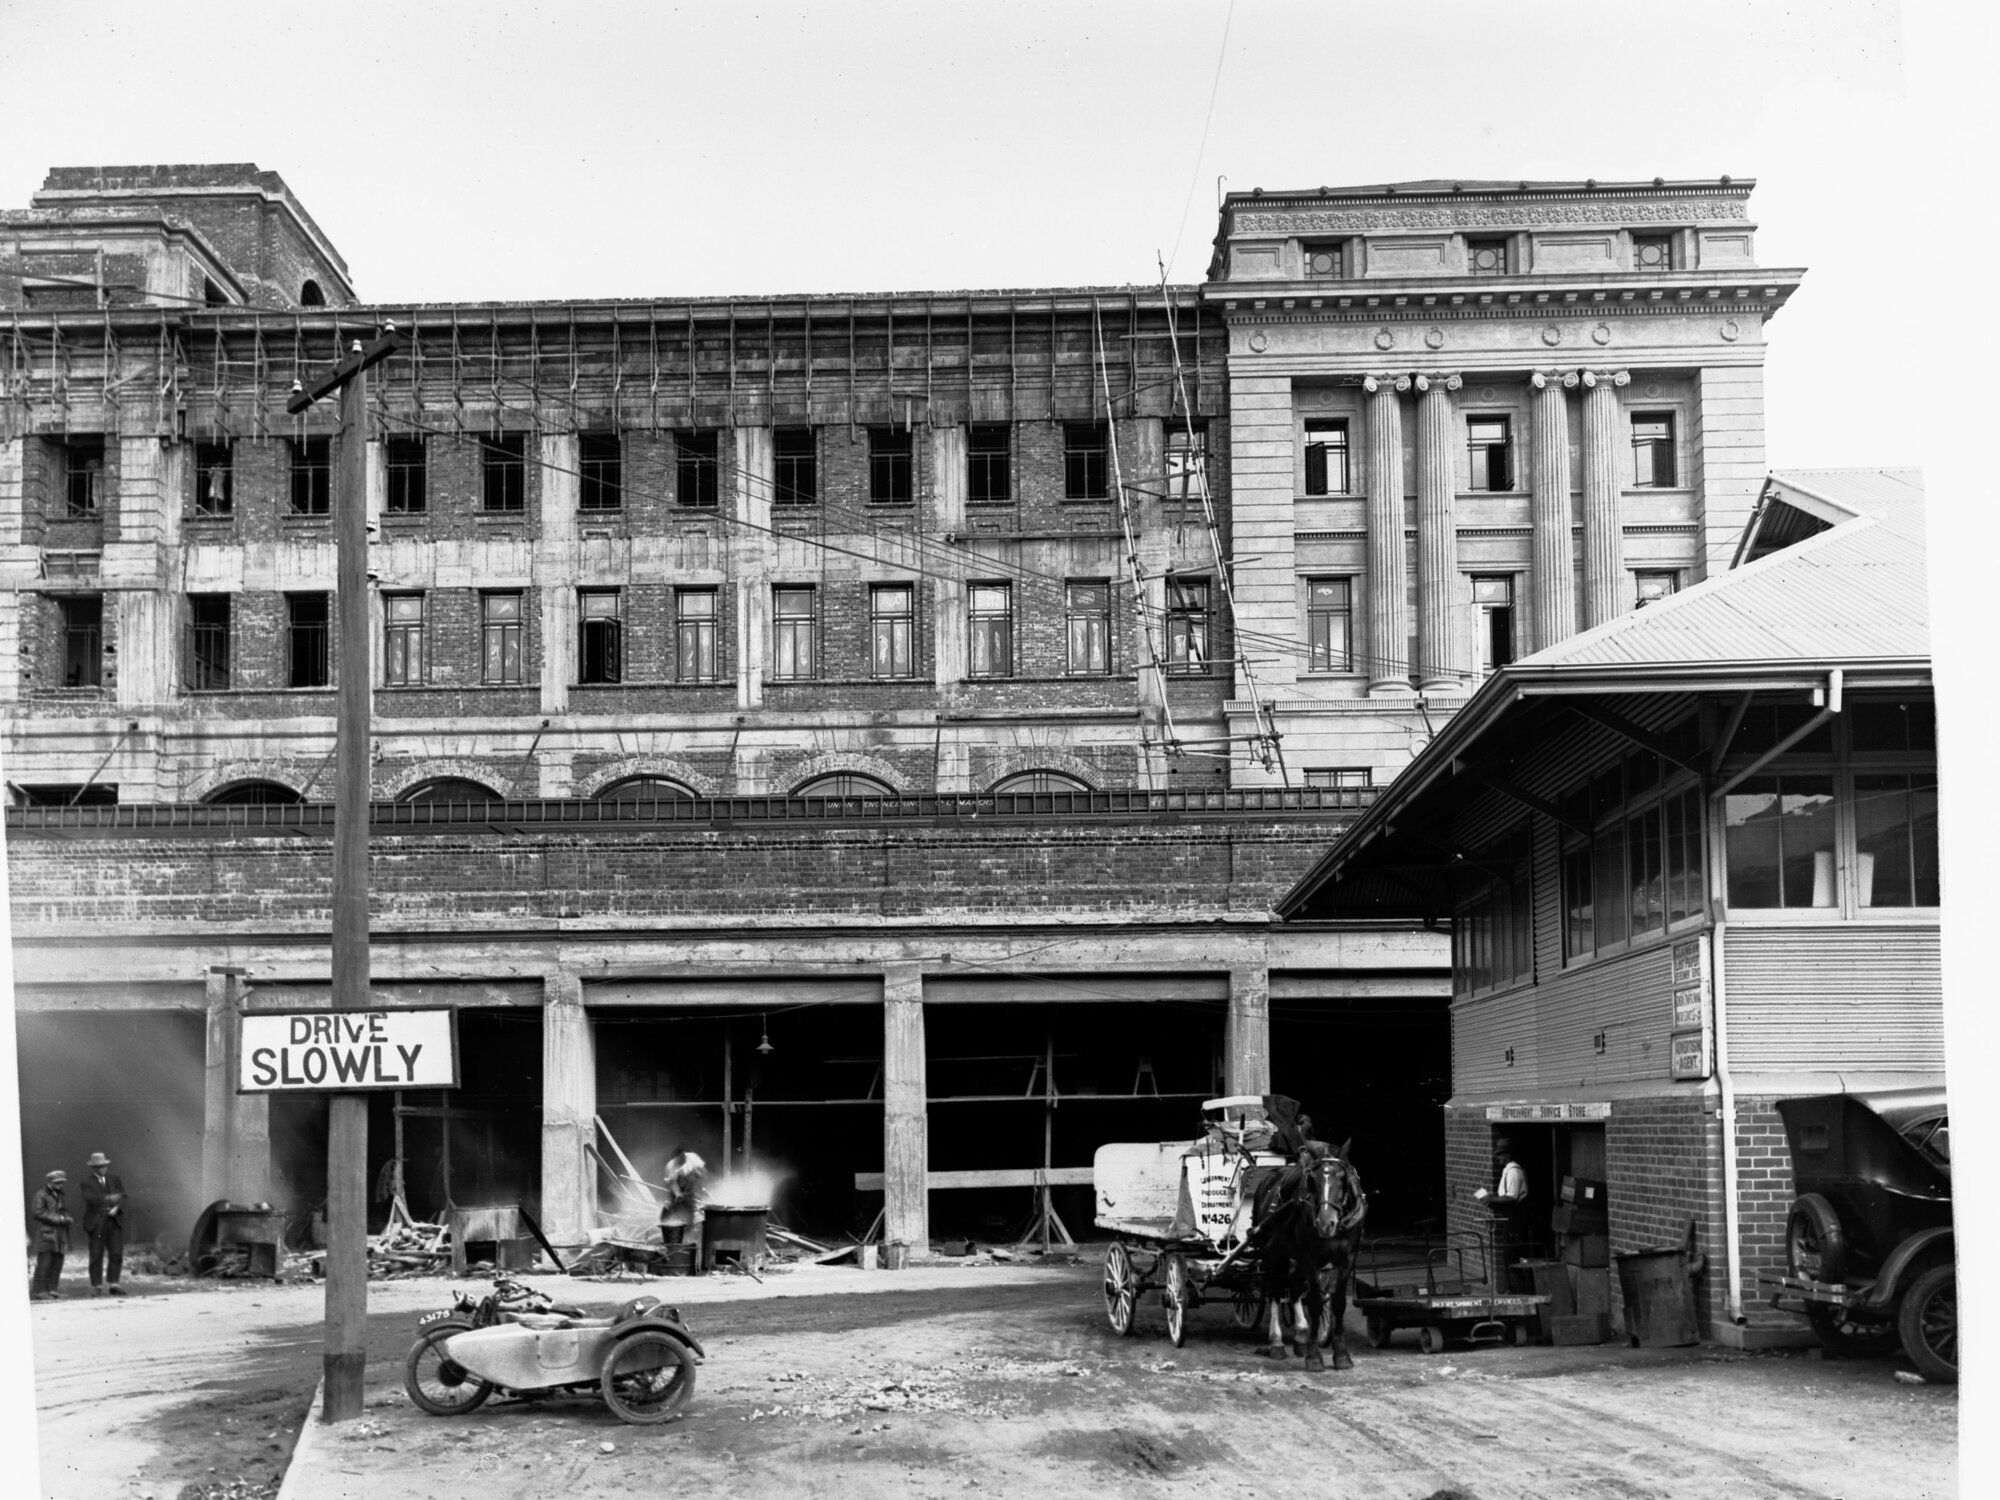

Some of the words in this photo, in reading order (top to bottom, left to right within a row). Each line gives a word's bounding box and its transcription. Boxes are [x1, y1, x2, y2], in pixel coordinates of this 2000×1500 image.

[863, 800, 920, 809] ENGNEERING
[290, 1012, 388, 1045] DRIVE
[1676, 1038, 1702, 1054] ADVERTISIN
[252, 1044, 423, 1086] SLOWLY
[1568, 1104, 1586, 1118] STORE
[1431, 1299, 1483, 1308] REFRESHMENT
